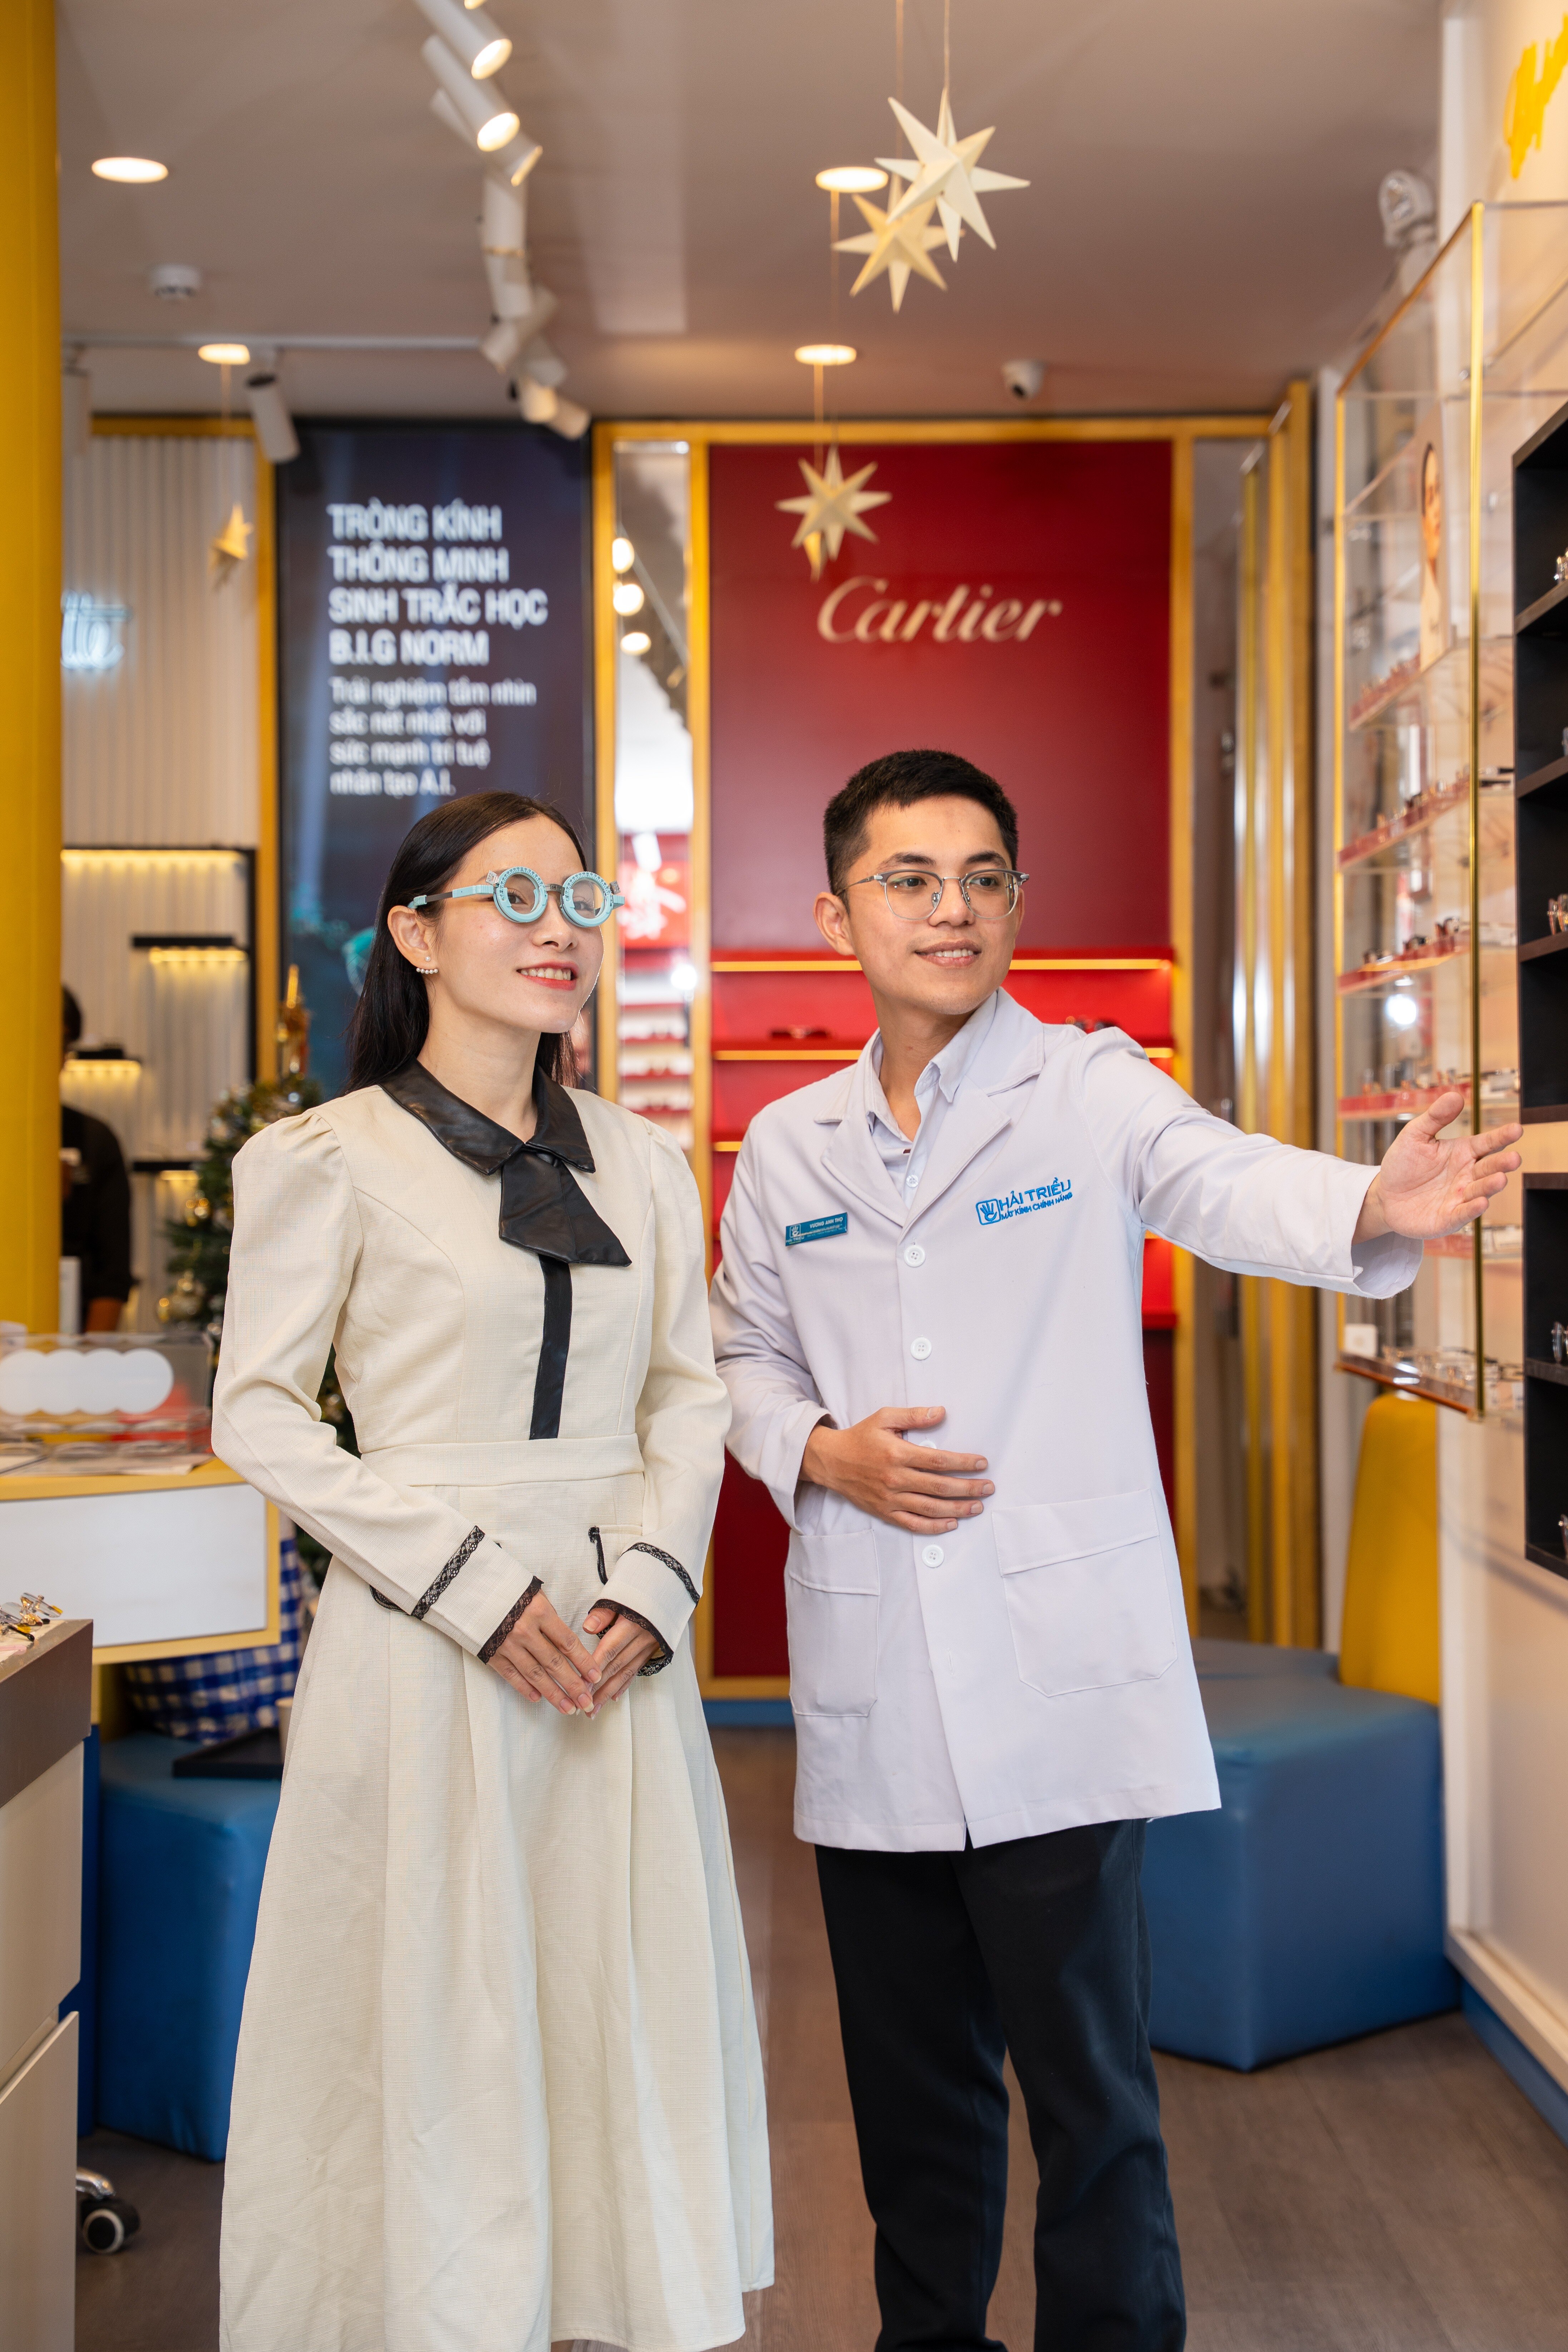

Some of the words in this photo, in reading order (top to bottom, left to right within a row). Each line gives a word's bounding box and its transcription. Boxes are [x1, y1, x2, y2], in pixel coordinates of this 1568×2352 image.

[327, 497, 428, 541] TRÒNG
[433, 498, 501, 540] KÍNH
[327, 541, 429, 582] THÔNG
[433, 547, 509, 583] MINH
[328, 587, 399, 623] SINH
[402, 582, 480, 624] TRẮC
[483, 588, 548, 630] HỌC
[817, 575, 1062, 642] Cartier
[328, 629, 397, 665] B.I.G
[400, 630, 489, 666] NORM
[999, 1190, 1024, 1211] HẢI
[1024, 1177, 1071, 1201] TRIỀU
